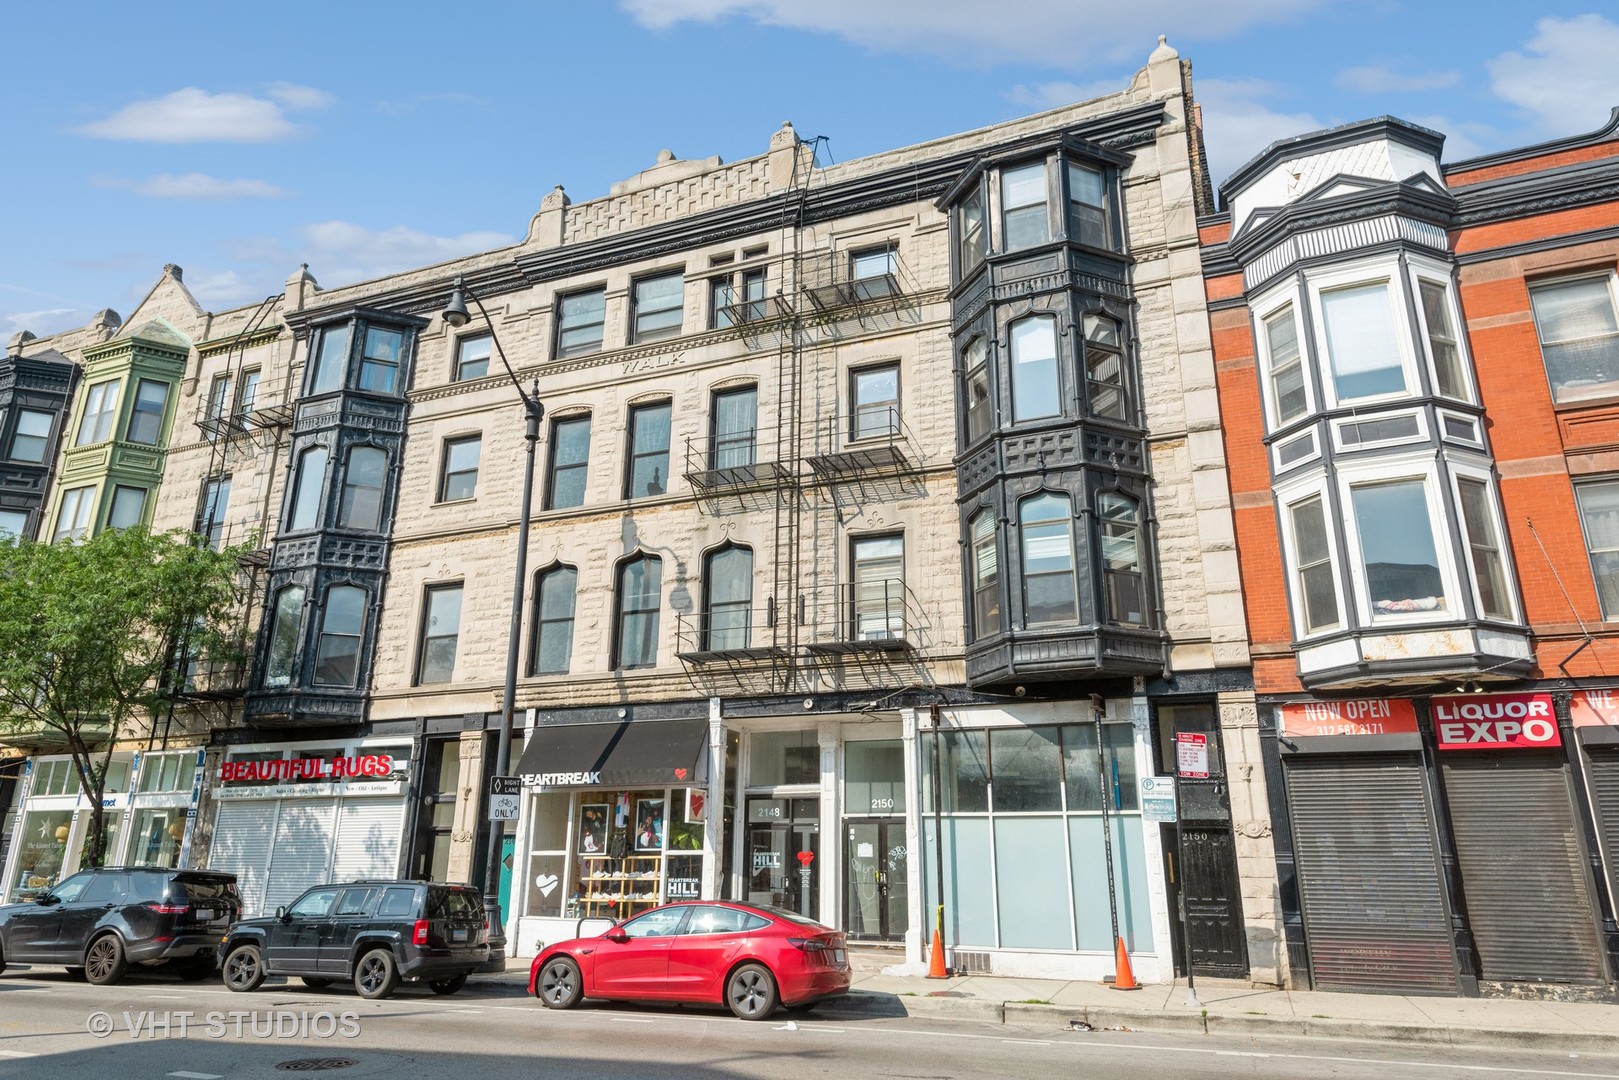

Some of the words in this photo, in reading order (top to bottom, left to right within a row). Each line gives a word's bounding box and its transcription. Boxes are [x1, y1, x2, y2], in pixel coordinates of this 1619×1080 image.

[622, 351, 686, 374] WALK
[1585, 690, 1616, 709] WE
[1304, 702, 1340, 721] NOW
[1346, 699, 1391, 719] OPEN
[1436, 701, 1549, 720] LIQUOR
[1440, 719, 1554, 744] EXPO
[221, 759, 326, 781] BEAUTIFUL
[332, 755, 393, 777] RUGS
[520, 771, 600, 785] HEARTBREAK
[871, 798, 894, 809] 2150
[495, 808, 514, 818] ONLY
[758, 807, 780, 817] 2148
[1182, 832, 1208, 841] 2150
[754, 855, 780, 866] HILL
[667, 882, 699, 894] HILL
